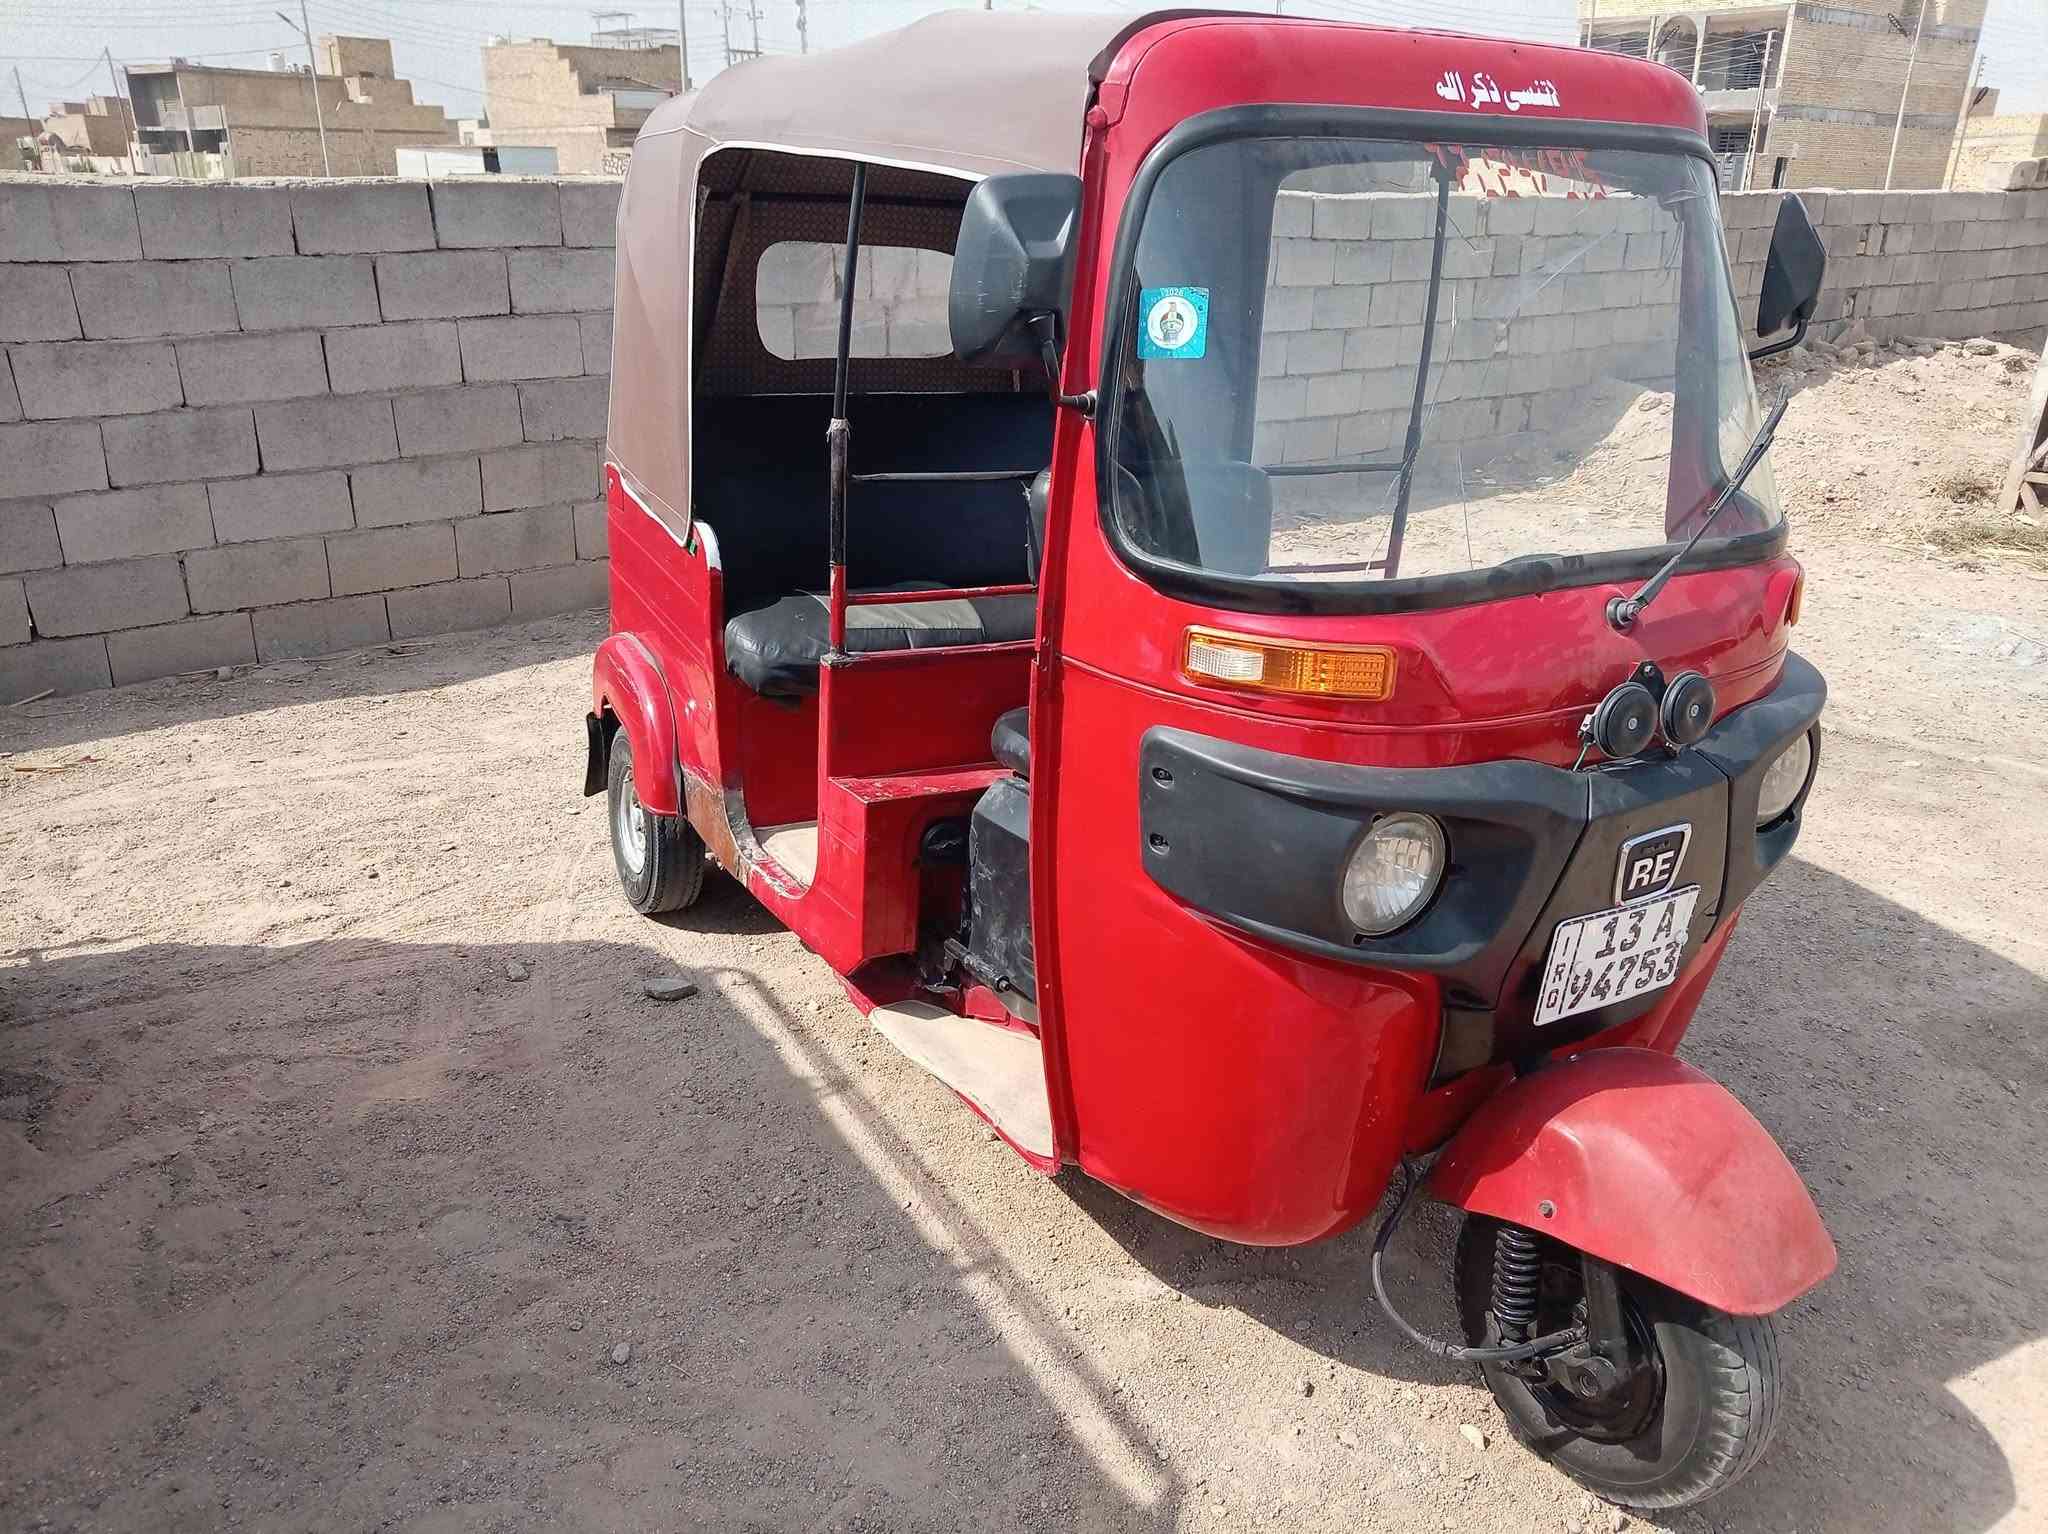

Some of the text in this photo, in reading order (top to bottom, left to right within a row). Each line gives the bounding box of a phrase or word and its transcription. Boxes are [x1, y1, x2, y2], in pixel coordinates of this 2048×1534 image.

[1435, 71, 1466, 102] الله
[1470, 72, 1502, 110] ذكر
[1627, 849, 1675, 891] RE
[1595, 899, 1676, 960] 13 A
[1568, 941, 1678, 1010] 94753
